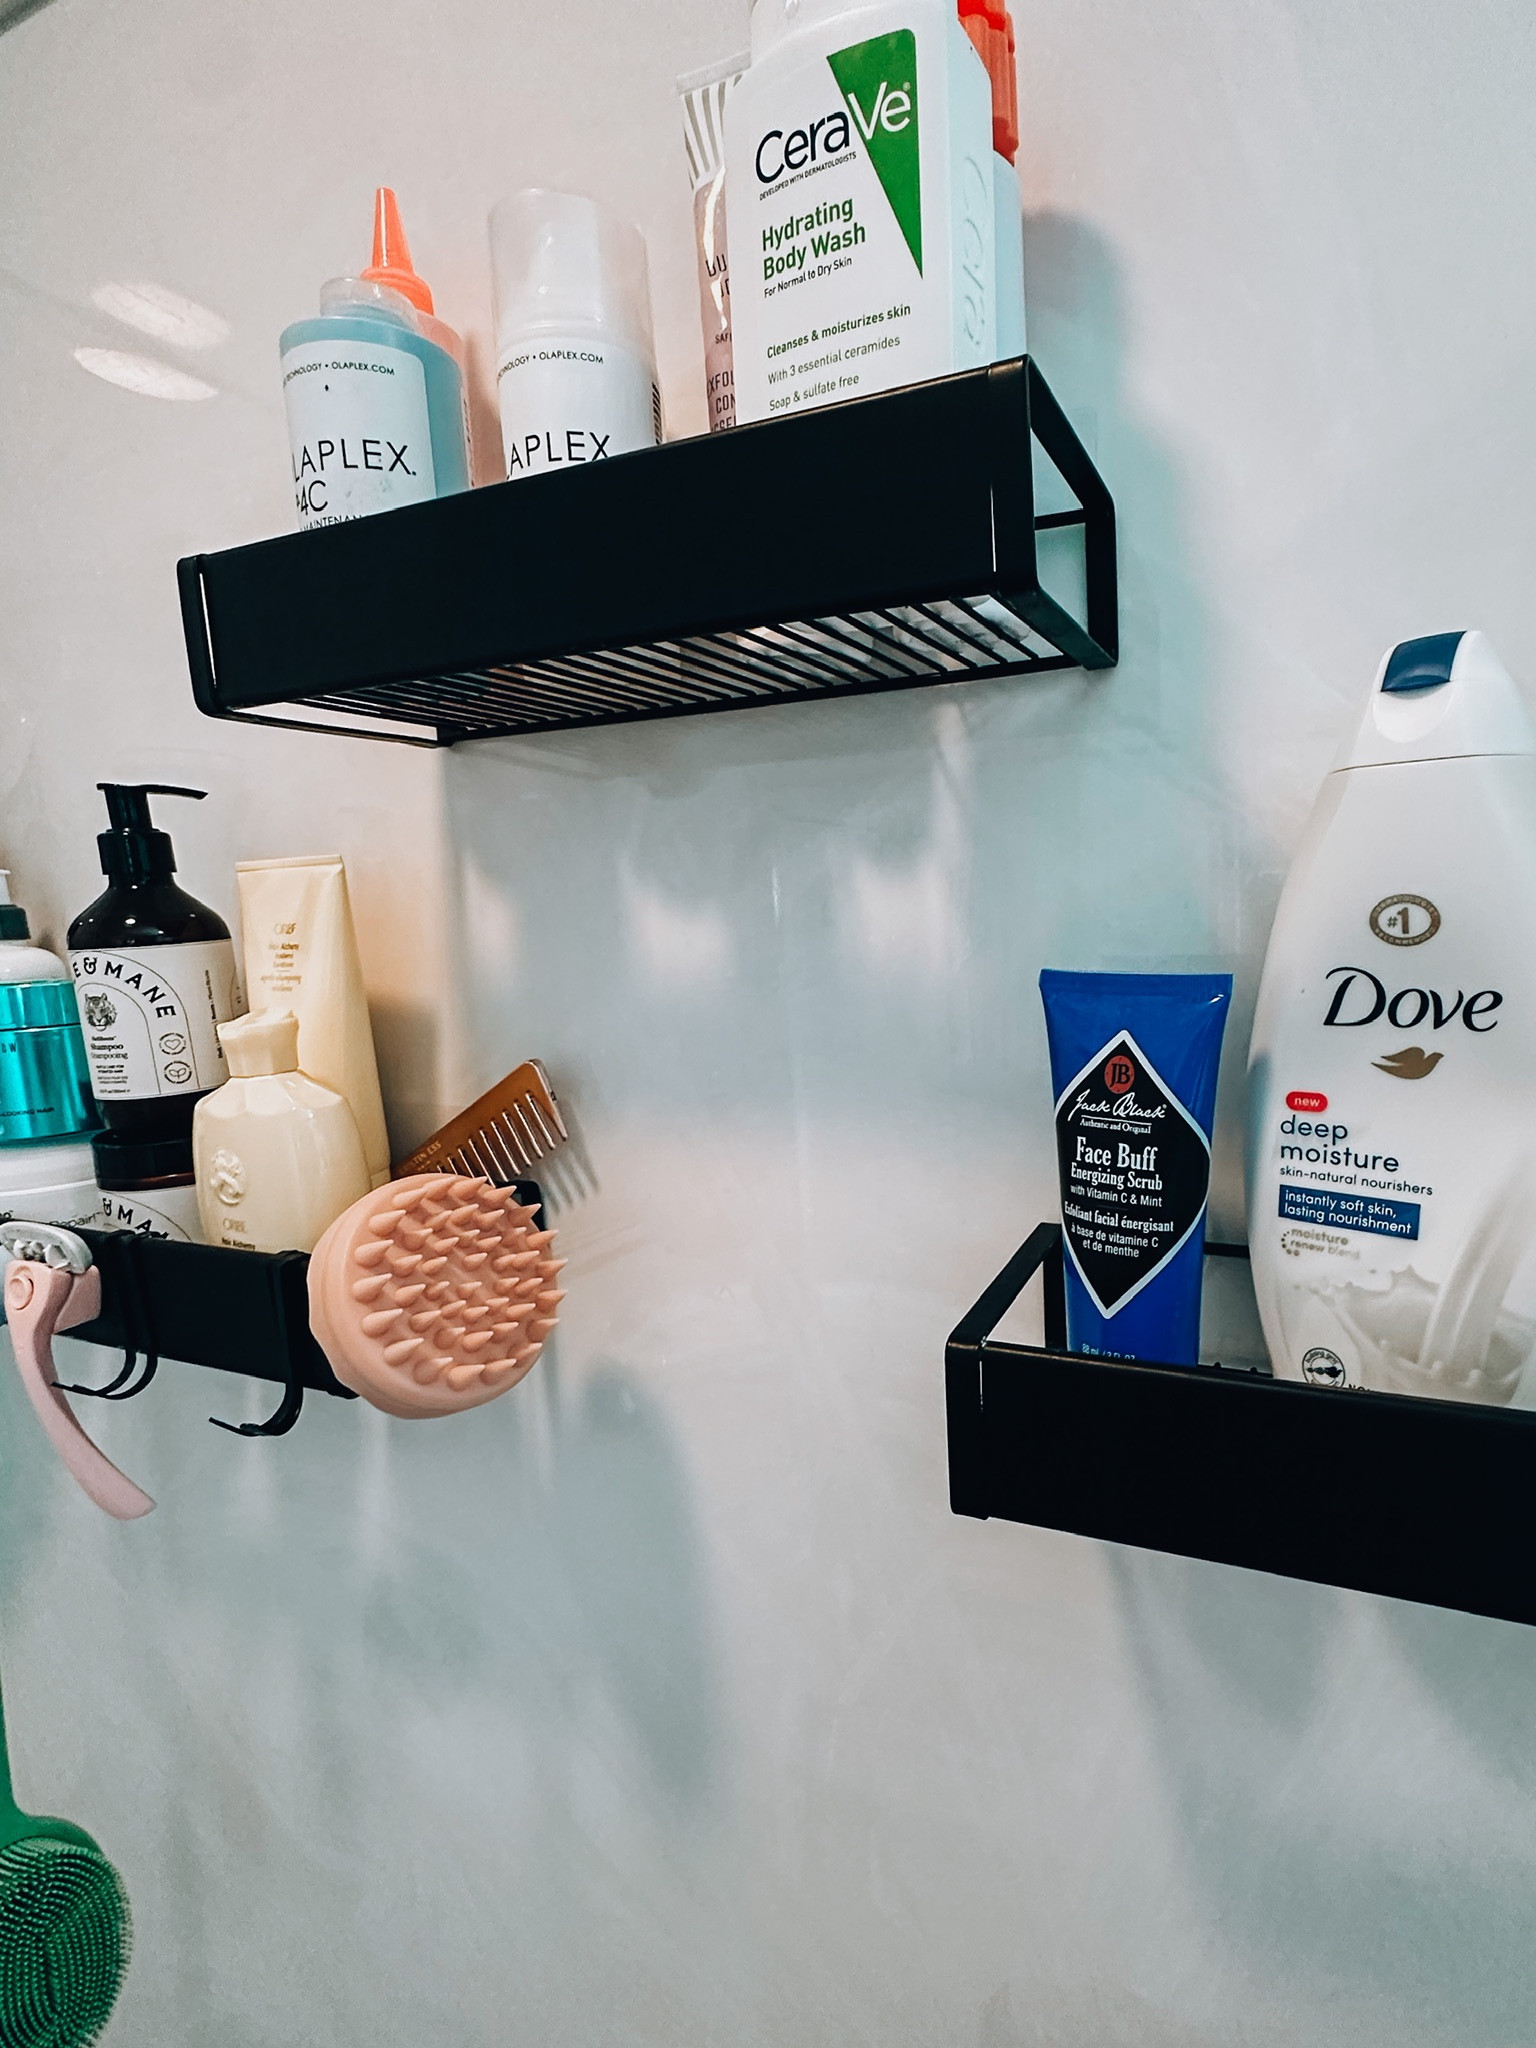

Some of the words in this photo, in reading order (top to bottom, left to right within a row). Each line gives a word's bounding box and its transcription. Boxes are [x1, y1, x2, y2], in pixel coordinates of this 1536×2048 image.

[755, 81, 911, 184] CeraVe
[759, 179, 789, 200] DEVELOPED
[789, 172, 804, 186] WITH
[804, 151, 857, 179] DERMATOLOGISTS
[762, 198, 854, 251] Hydrating
[763, 246, 807, 281] Body
[811, 222, 866, 258] Wash
[764, 285, 777, 298] For
[777, 272, 807, 291] Normal
[808, 269, 816, 280] to
[817, 264, 832, 277] Dry
[833, 256, 853, 271] Skin
[767, 335, 809, 359] Cleanses
[811, 329, 819, 341] &
[821, 311, 884, 338] moisturizes
[887, 303, 911, 320] skin
[331, 361, 395, 375] OLAPLEX.COM
[539, 350, 604, 364] OLAPLEX.COM
[767, 368, 788, 385] With
[789, 364, 796, 377] 3
[797, 349, 842, 373] essential
[844, 336, 901, 360] ceramides
[769, 394, 791, 411] Soap
[793, 390, 801, 402] &
[803, 380, 836, 399] sulfate
[839, 374, 860, 389] free
[507, 430, 610, 480] APLEX
[295, 480, 328, 515] 4C
[104, 960, 177, 1018] MANE
[1323, 966, 1503, 1032] Dove
[1109, 1062, 1131, 1088] JB
[1067, 1088, 1111, 1122] Jack
[1112, 1092, 1165, 1118] Black
[1294, 1096, 1320, 1108] new
[1080, 1118, 1109, 1130] Authentic
[1109, 1122, 1121, 1130] and
[1122, 1122, 1151, 1135] Original
[1280, 1114, 1348, 1146] deep
[1075, 1135, 1112, 1166] Face
[1116, 1142, 1159, 1171] Buff
[1280, 1143, 1399, 1173] moisture
[1071, 1161, 1125, 1190] Energizing
[1127, 1170, 1163, 1191] Scrub
[1280, 1165, 1357, 1185] skin-natural
[1361, 1176, 1433, 1196] nourishers
[1070, 1184, 1085, 1196] with
[1086, 1186, 1118, 1202] Vitamin
[1120, 1192, 1128, 1203] C
[1129, 1193, 1138, 1205] &
[1140, 1194, 1163, 1207] Mint
[1285, 1189, 1337, 1211] instantly
[1340, 1199, 1364, 1212] soft
[1367, 1204, 1397, 1219] skin,
[1094, 1209, 1119, 1227] facial
[1121, 1215, 1174, 1234] énergisant
[1284, 1203, 1325, 1223] lasting
[1328, 1211, 1412, 1234] nourishment
[1076, 1224, 1094, 1238] base
[1095, 1230, 1107, 1240] de
[1108, 1232, 1149, 1247] vitamine
[1151, 1236, 1159, 1248] C
[1082, 1238, 1090, 1249] et
[1092, 1240, 1103, 1251] de
[1104, 1244, 1140, 1258] menthe
[1290, 1239, 1324, 1254] renew
[1291, 1228, 1349, 1246] moisture
